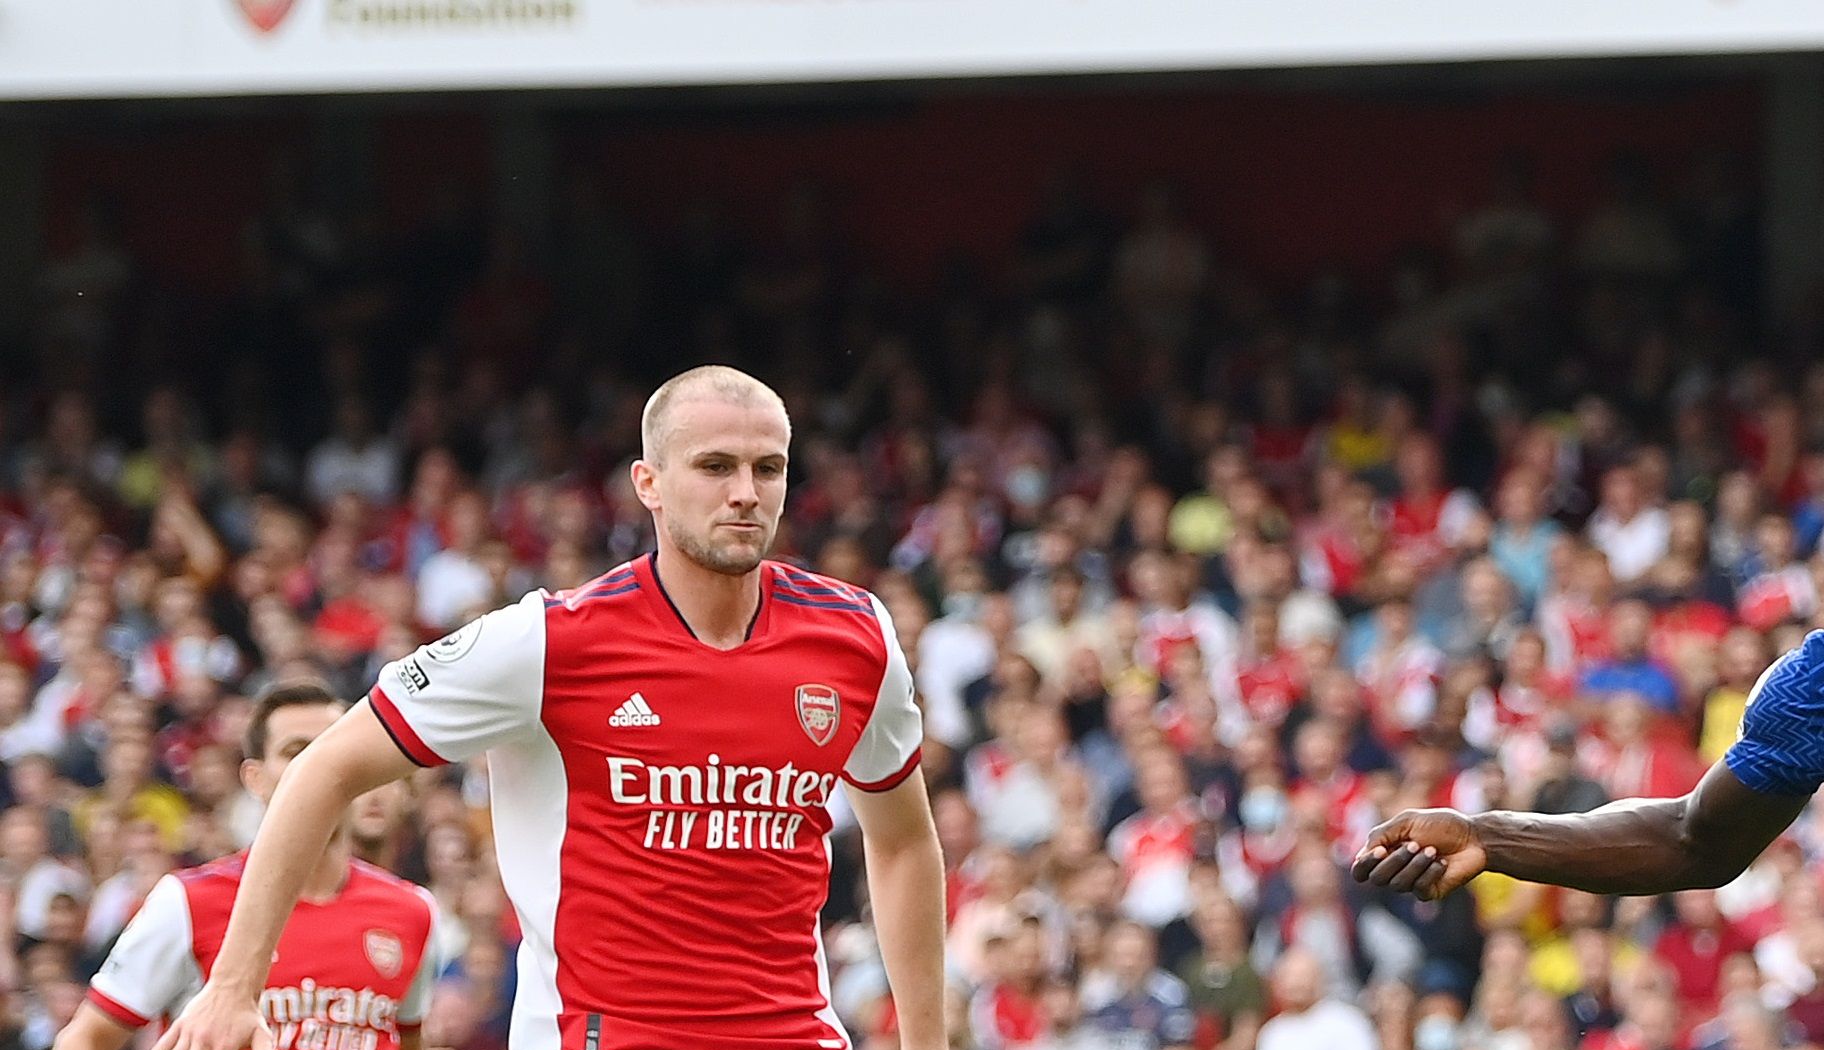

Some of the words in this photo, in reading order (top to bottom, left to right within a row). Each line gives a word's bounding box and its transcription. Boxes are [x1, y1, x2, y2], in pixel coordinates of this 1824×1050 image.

[608, 713, 661, 727] adidas
[605, 753, 835, 808] Emirates
[643, 811, 698, 849] FLY
[705, 809, 804, 850] BETTER
